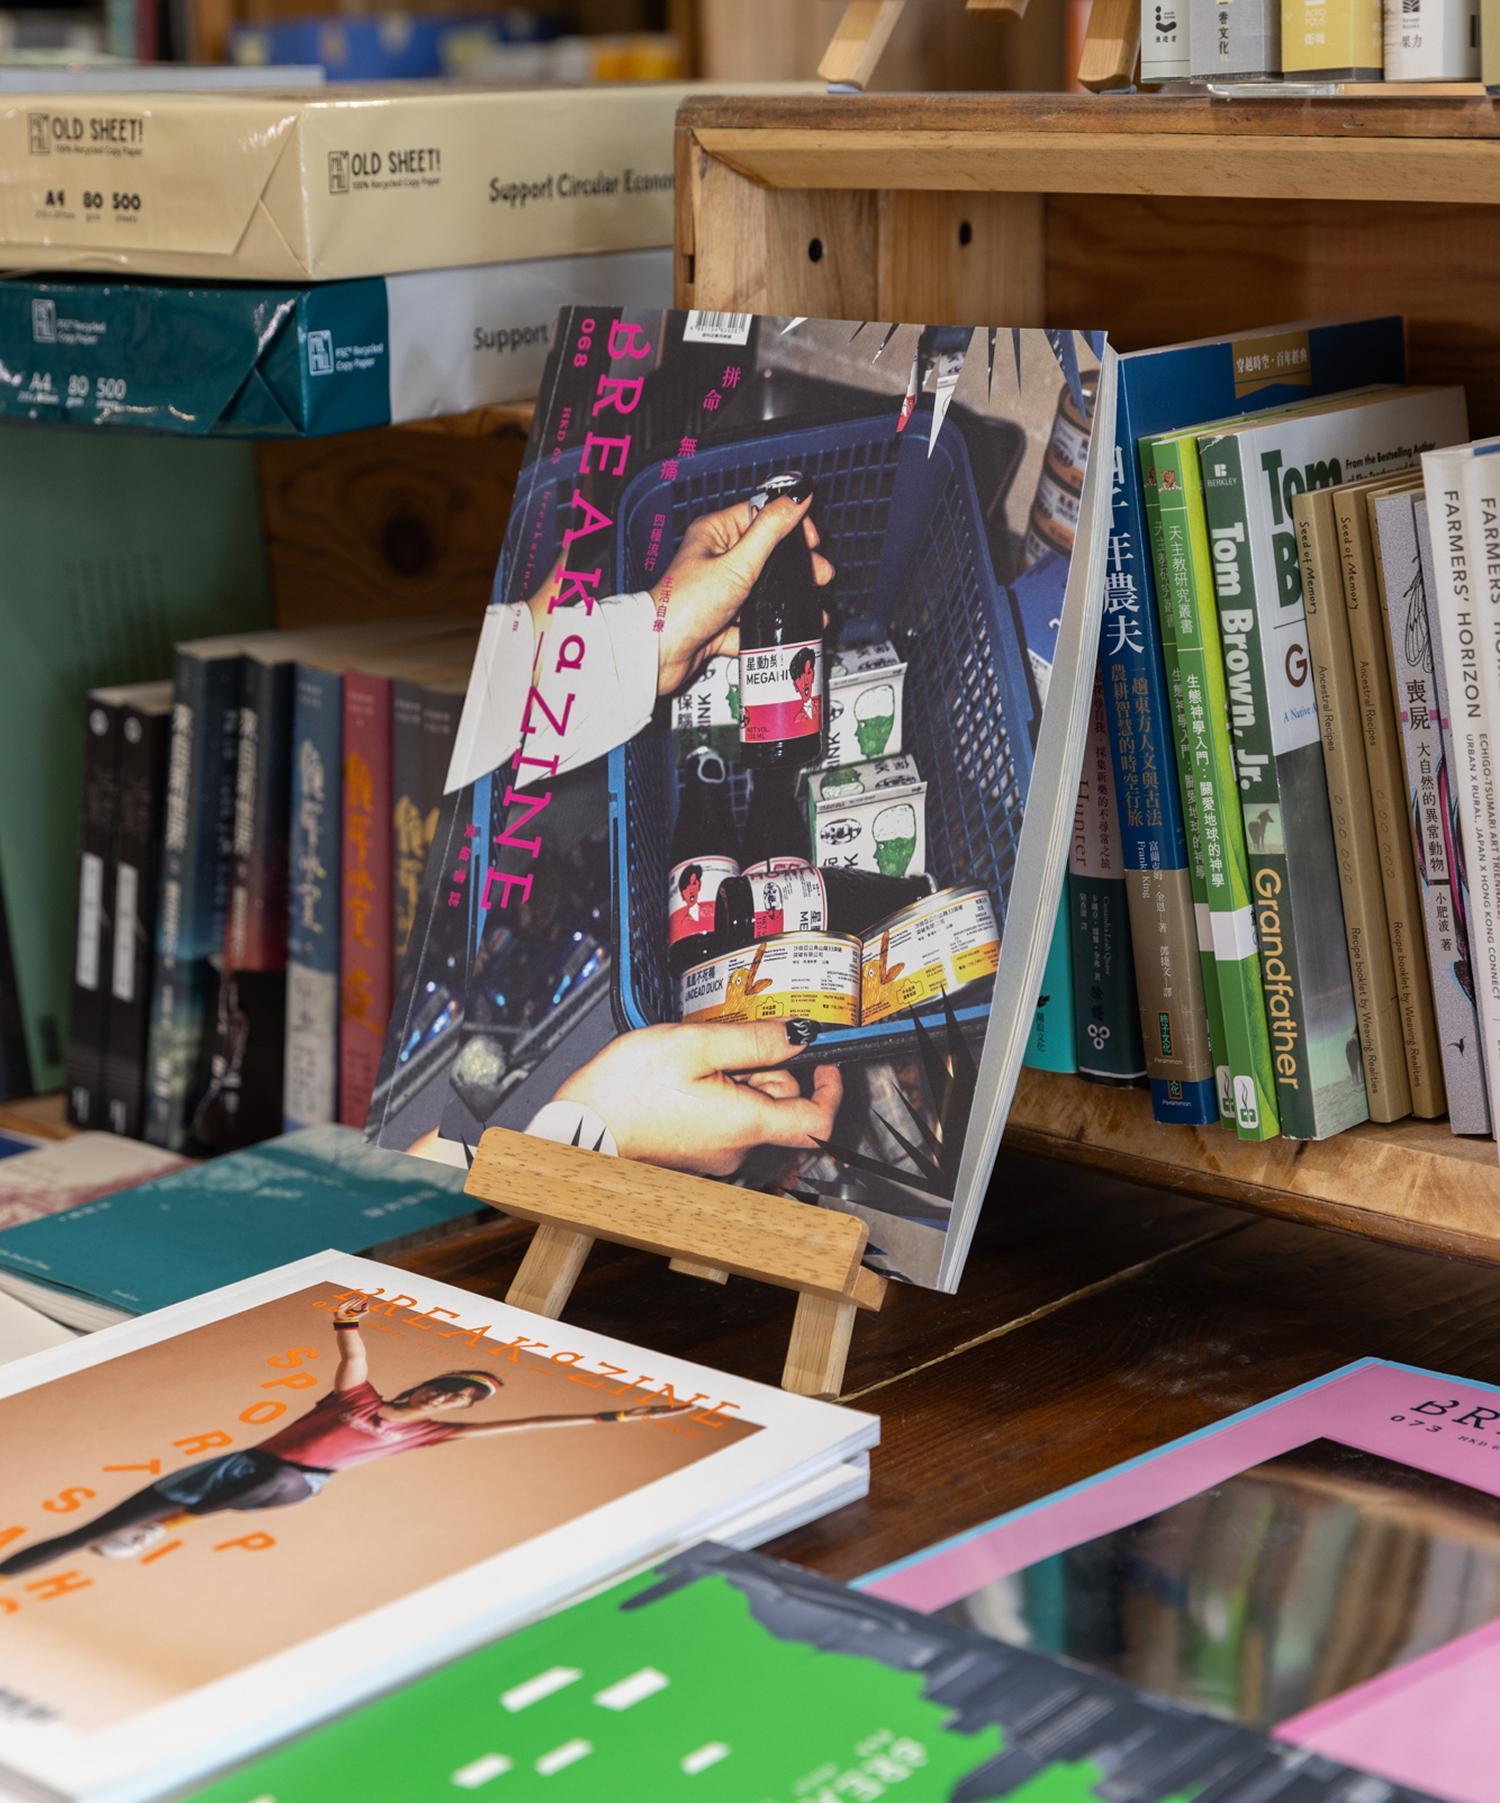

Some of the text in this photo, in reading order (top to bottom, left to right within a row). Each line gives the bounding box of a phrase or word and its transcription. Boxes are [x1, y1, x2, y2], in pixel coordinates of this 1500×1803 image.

[52, 117, 144, 142] OLD SHEET!
[352, 149, 441, 176] OLD SHEET!
[45, 190, 65, 207] A4
[83, 191, 103, 209] 80
[112, 192, 141, 210] 500
[490, 174, 554, 208] Support
[557, 172, 618, 198] Circular
[473, 323, 549, 354] Support
[571, 318, 595, 368] 068
[29, 371, 52, 391] A4
[68, 375, 89, 394] 80
[97, 377, 127, 400] 500
[557, 407, 572, 441] HKD
[1345, 440, 1436, 470] From the Bestselling Author
[1207, 477, 1238, 488] BERKLEY
[1260, 449, 1344, 526] Tom
[1168, 525, 1193, 634] 天主教研究叢書
[1299, 520, 1317, 615] Seed of Memory
[1340, 516, 1359, 610] Seed of Memory
[1444, 490, 1481, 718] FARMERS' HORIZON
[1212, 521, 1269, 791] Tom Brown, Jr.
[1290, 706, 1312, 721] Native
[1318, 665, 1335, 752] Ancestral Recipes
[1359, 660, 1376, 747] Ancestral Recipes
[1406, 679, 1431, 730] 喪屍
[1466, 734, 1477, 773] URBAN
[1417, 741, 1445, 872] 大自然的異常動物
[1480, 733, 1497, 829] ECHIGO-TSUMARI
[1489, 830, 1499, 851] ART
[1475, 826, 1486, 863] JAPAN
[1481, 875, 1491, 909] HONG
[1435, 892, 1452, 952] 小肥波 著
[1484, 911, 1495, 945] KONG
[1255, 867, 1299, 1089] Grandfather
[1488, 944, 1500, 999] CONNECT
[1352, 927, 1378, 1094] Recipe booklet by Weaving Realities
[1393, 921, 1422, 1088] Recipe booklet by Weaving Realities
[1390, 1415, 1443, 1433] 073
[1409, 1399, 1500, 1436] BR
